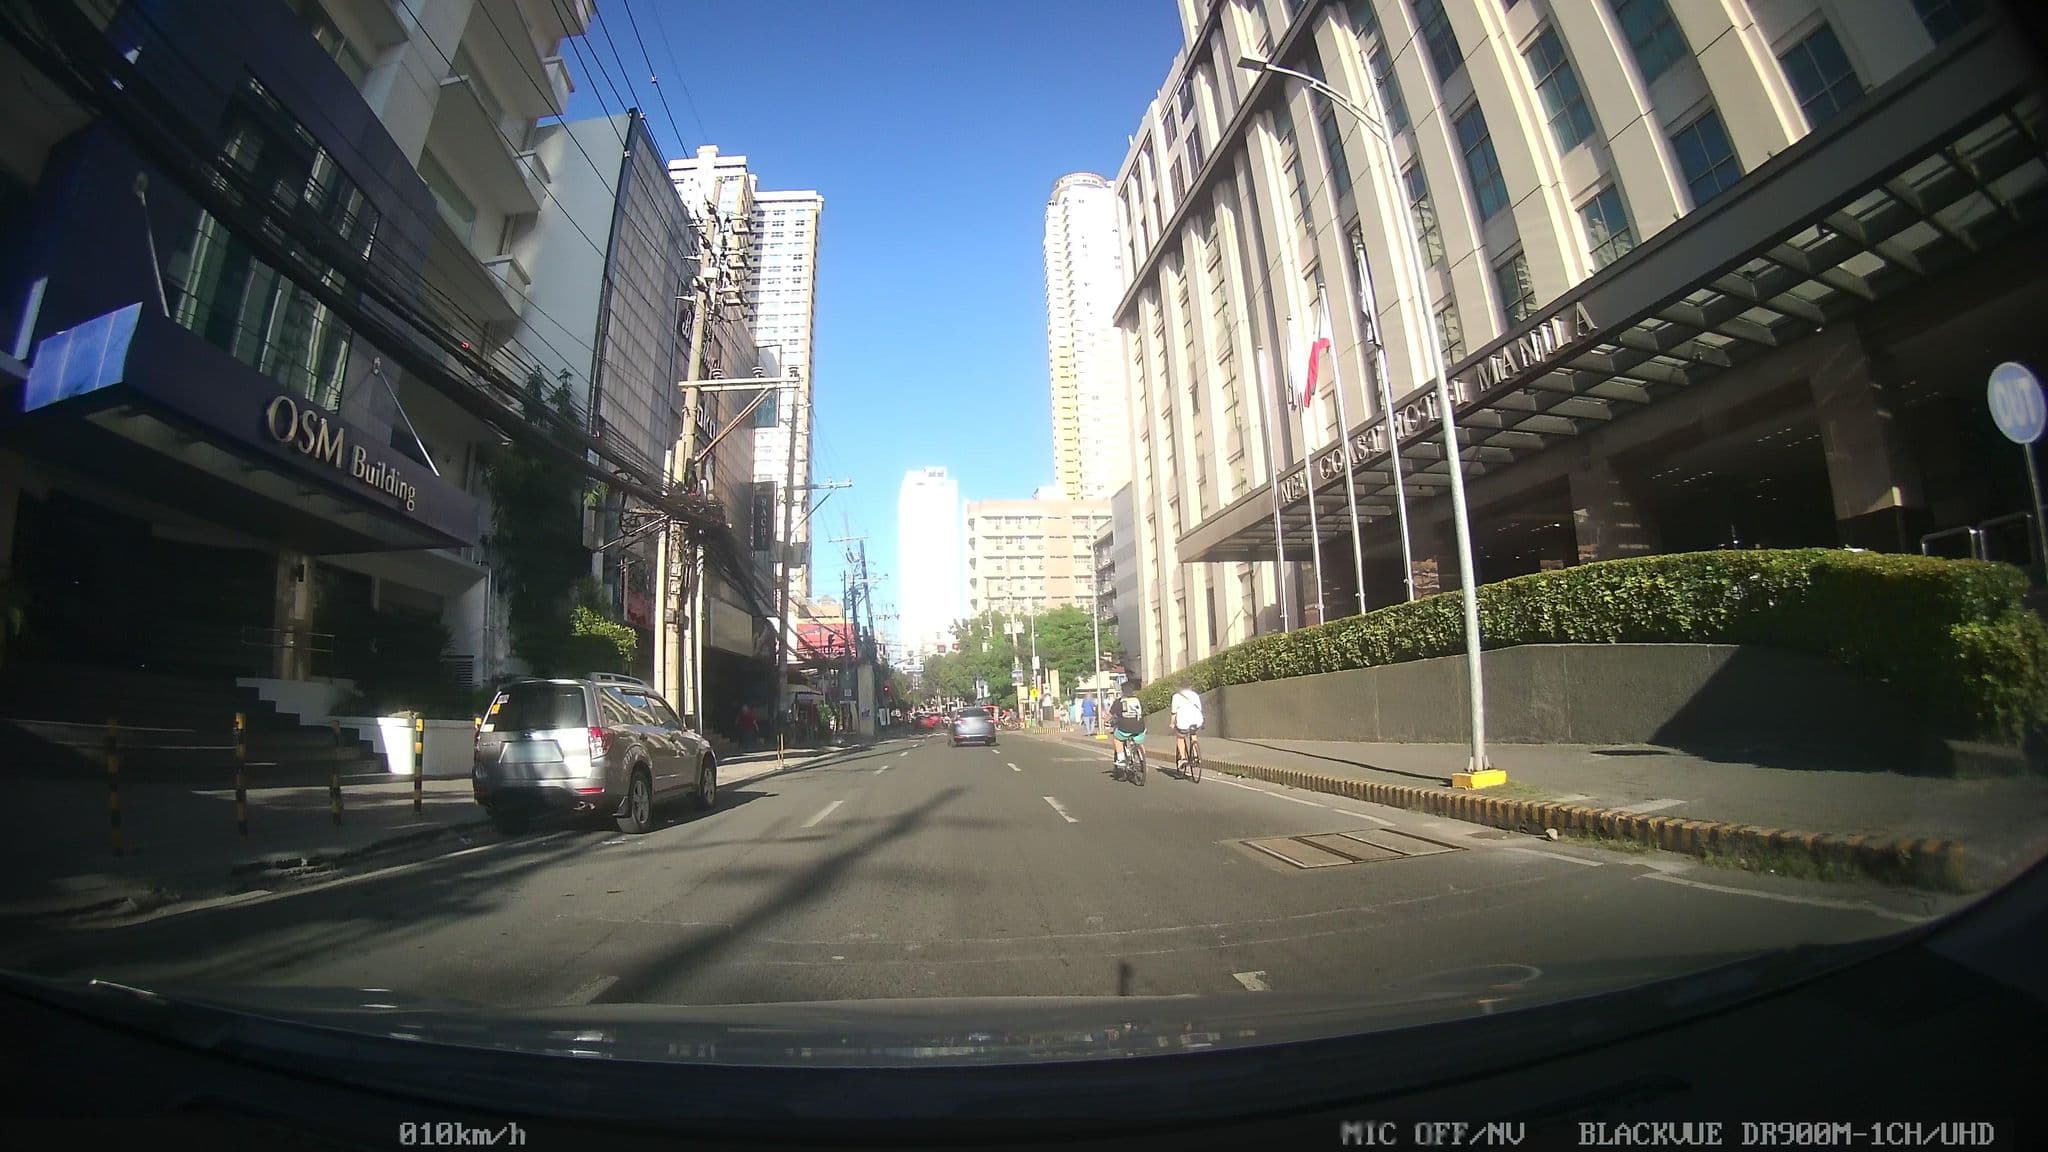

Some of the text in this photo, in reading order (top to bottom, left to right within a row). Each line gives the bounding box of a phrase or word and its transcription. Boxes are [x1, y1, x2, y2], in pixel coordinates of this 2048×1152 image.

[1475, 301, 1599, 392] MANILA
[266, 395, 416, 511] OSM Building
